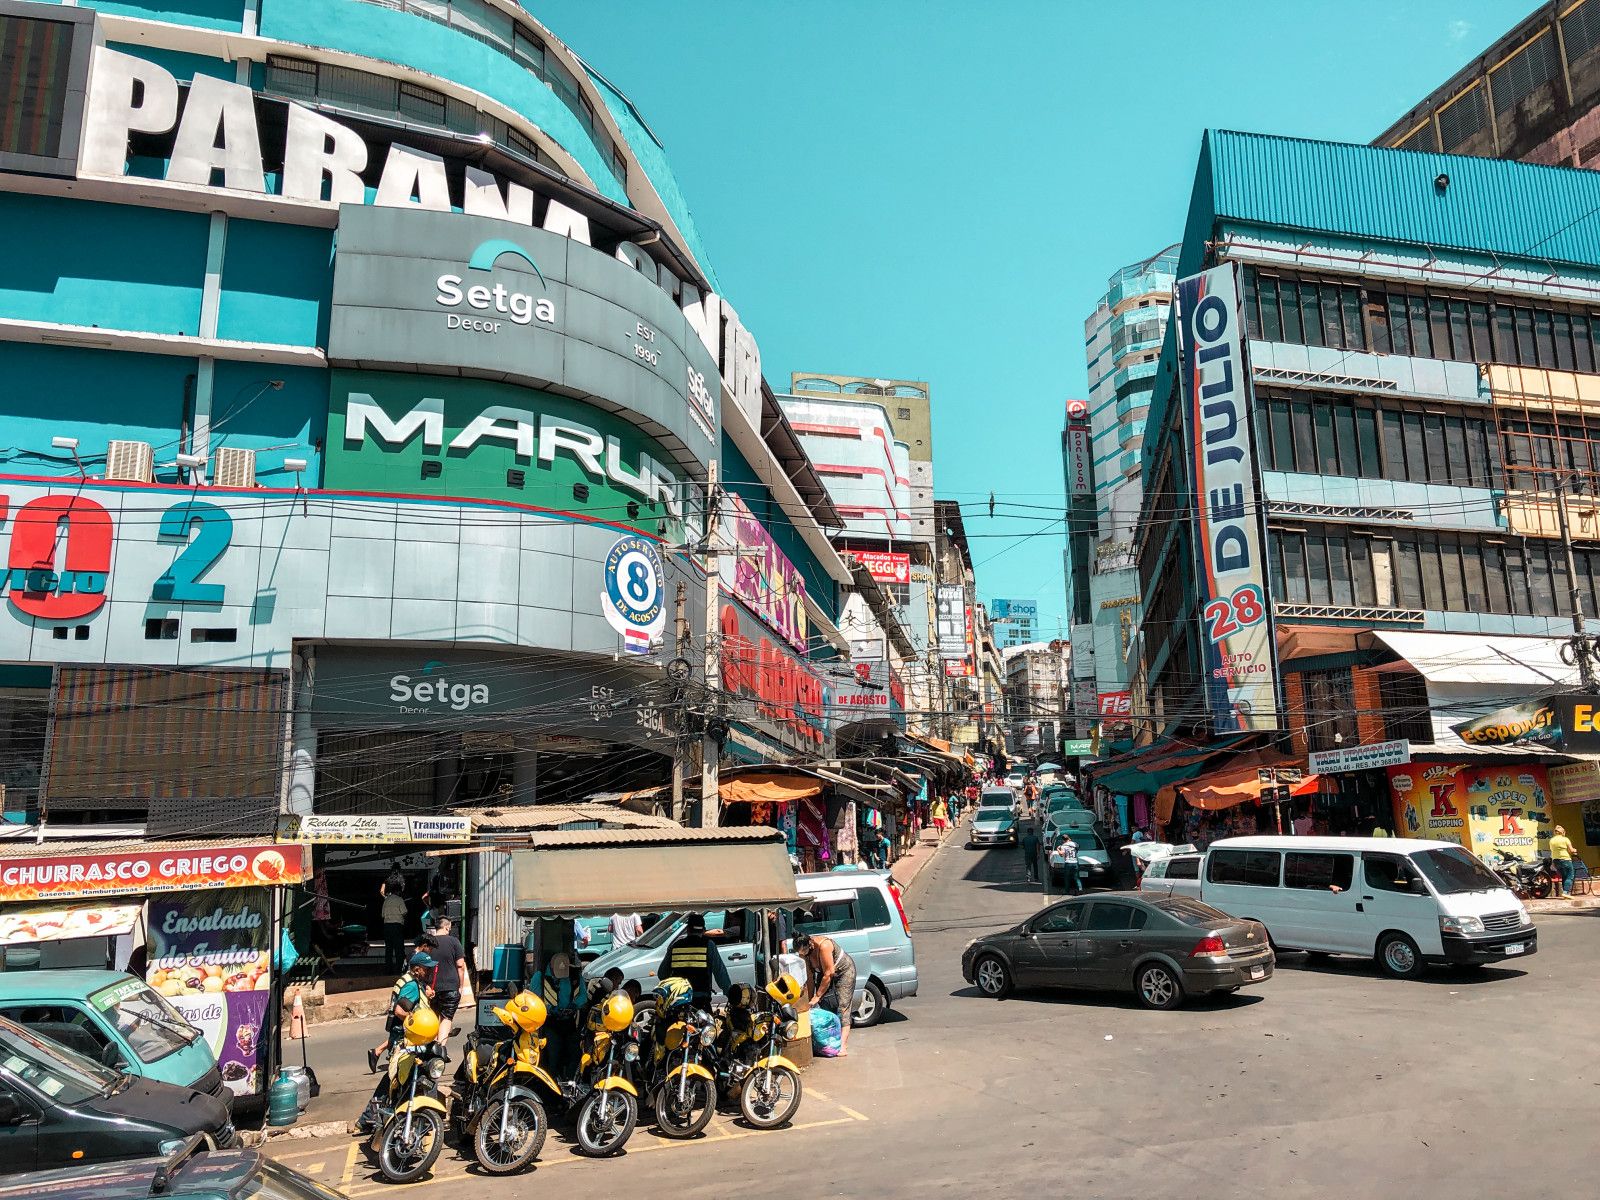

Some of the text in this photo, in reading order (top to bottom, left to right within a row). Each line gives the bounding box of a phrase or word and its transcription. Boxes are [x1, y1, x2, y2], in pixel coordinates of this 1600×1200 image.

[436, 273, 556, 325] Setga
[447, 313, 501, 335] Decor
[636, 322, 656, 344] EST
[633, 343, 657, 367] 1990
[1195, 295, 1250, 573] DE JULIO
[151, 501, 234, 604] 2
[607, 540, 664, 588] AUTO SERVICIO
[627, 561, 649, 602] 8
[615, 599, 659, 623] DE AGOSTO
[1012, 604, 1036, 616] shop
[1204, 588, 1264, 641] 28
[1222, 653, 1252, 665] AUTO
[1213, 663, 1267, 679] SERVICIO
[390, 674, 490, 711] Setga
[838, 694, 887, 705] DE AGOSTO
[1461, 707, 1554, 744] Ecopower
[1314, 743, 1404, 766] TAXI TRICOLOR
[1317, 764, 1342, 774] PARADA
[1343, 763, 1351, 771] 46
[1355, 761, 1371, 769] RES.
[1429, 782, 1459, 818] K
[1488, 790, 1528, 806] SUPER
[306, 817, 349, 828] Reducto
[351, 817, 381, 828] Ltda.
[413, 820, 465, 830] Transporte
[1428, 819, 1464, 828] SHOPPING
[1498, 807, 1524, 837] K
[414, 832, 451, 840] Alternativo
[1494, 837, 1533, 847] SHOPPING
[3, 854, 248, 886] CHURRASCO GRIEGO
[38, 890, 76, 898] Gaseosas
[82, 886, 138, 896] Hamburguesas
[180, 883, 202, 891] Jugos
[162, 907, 261, 934] Ensalada
[160, 942, 260, 969] de Frutas
[202, 1003, 222, 1021] de
